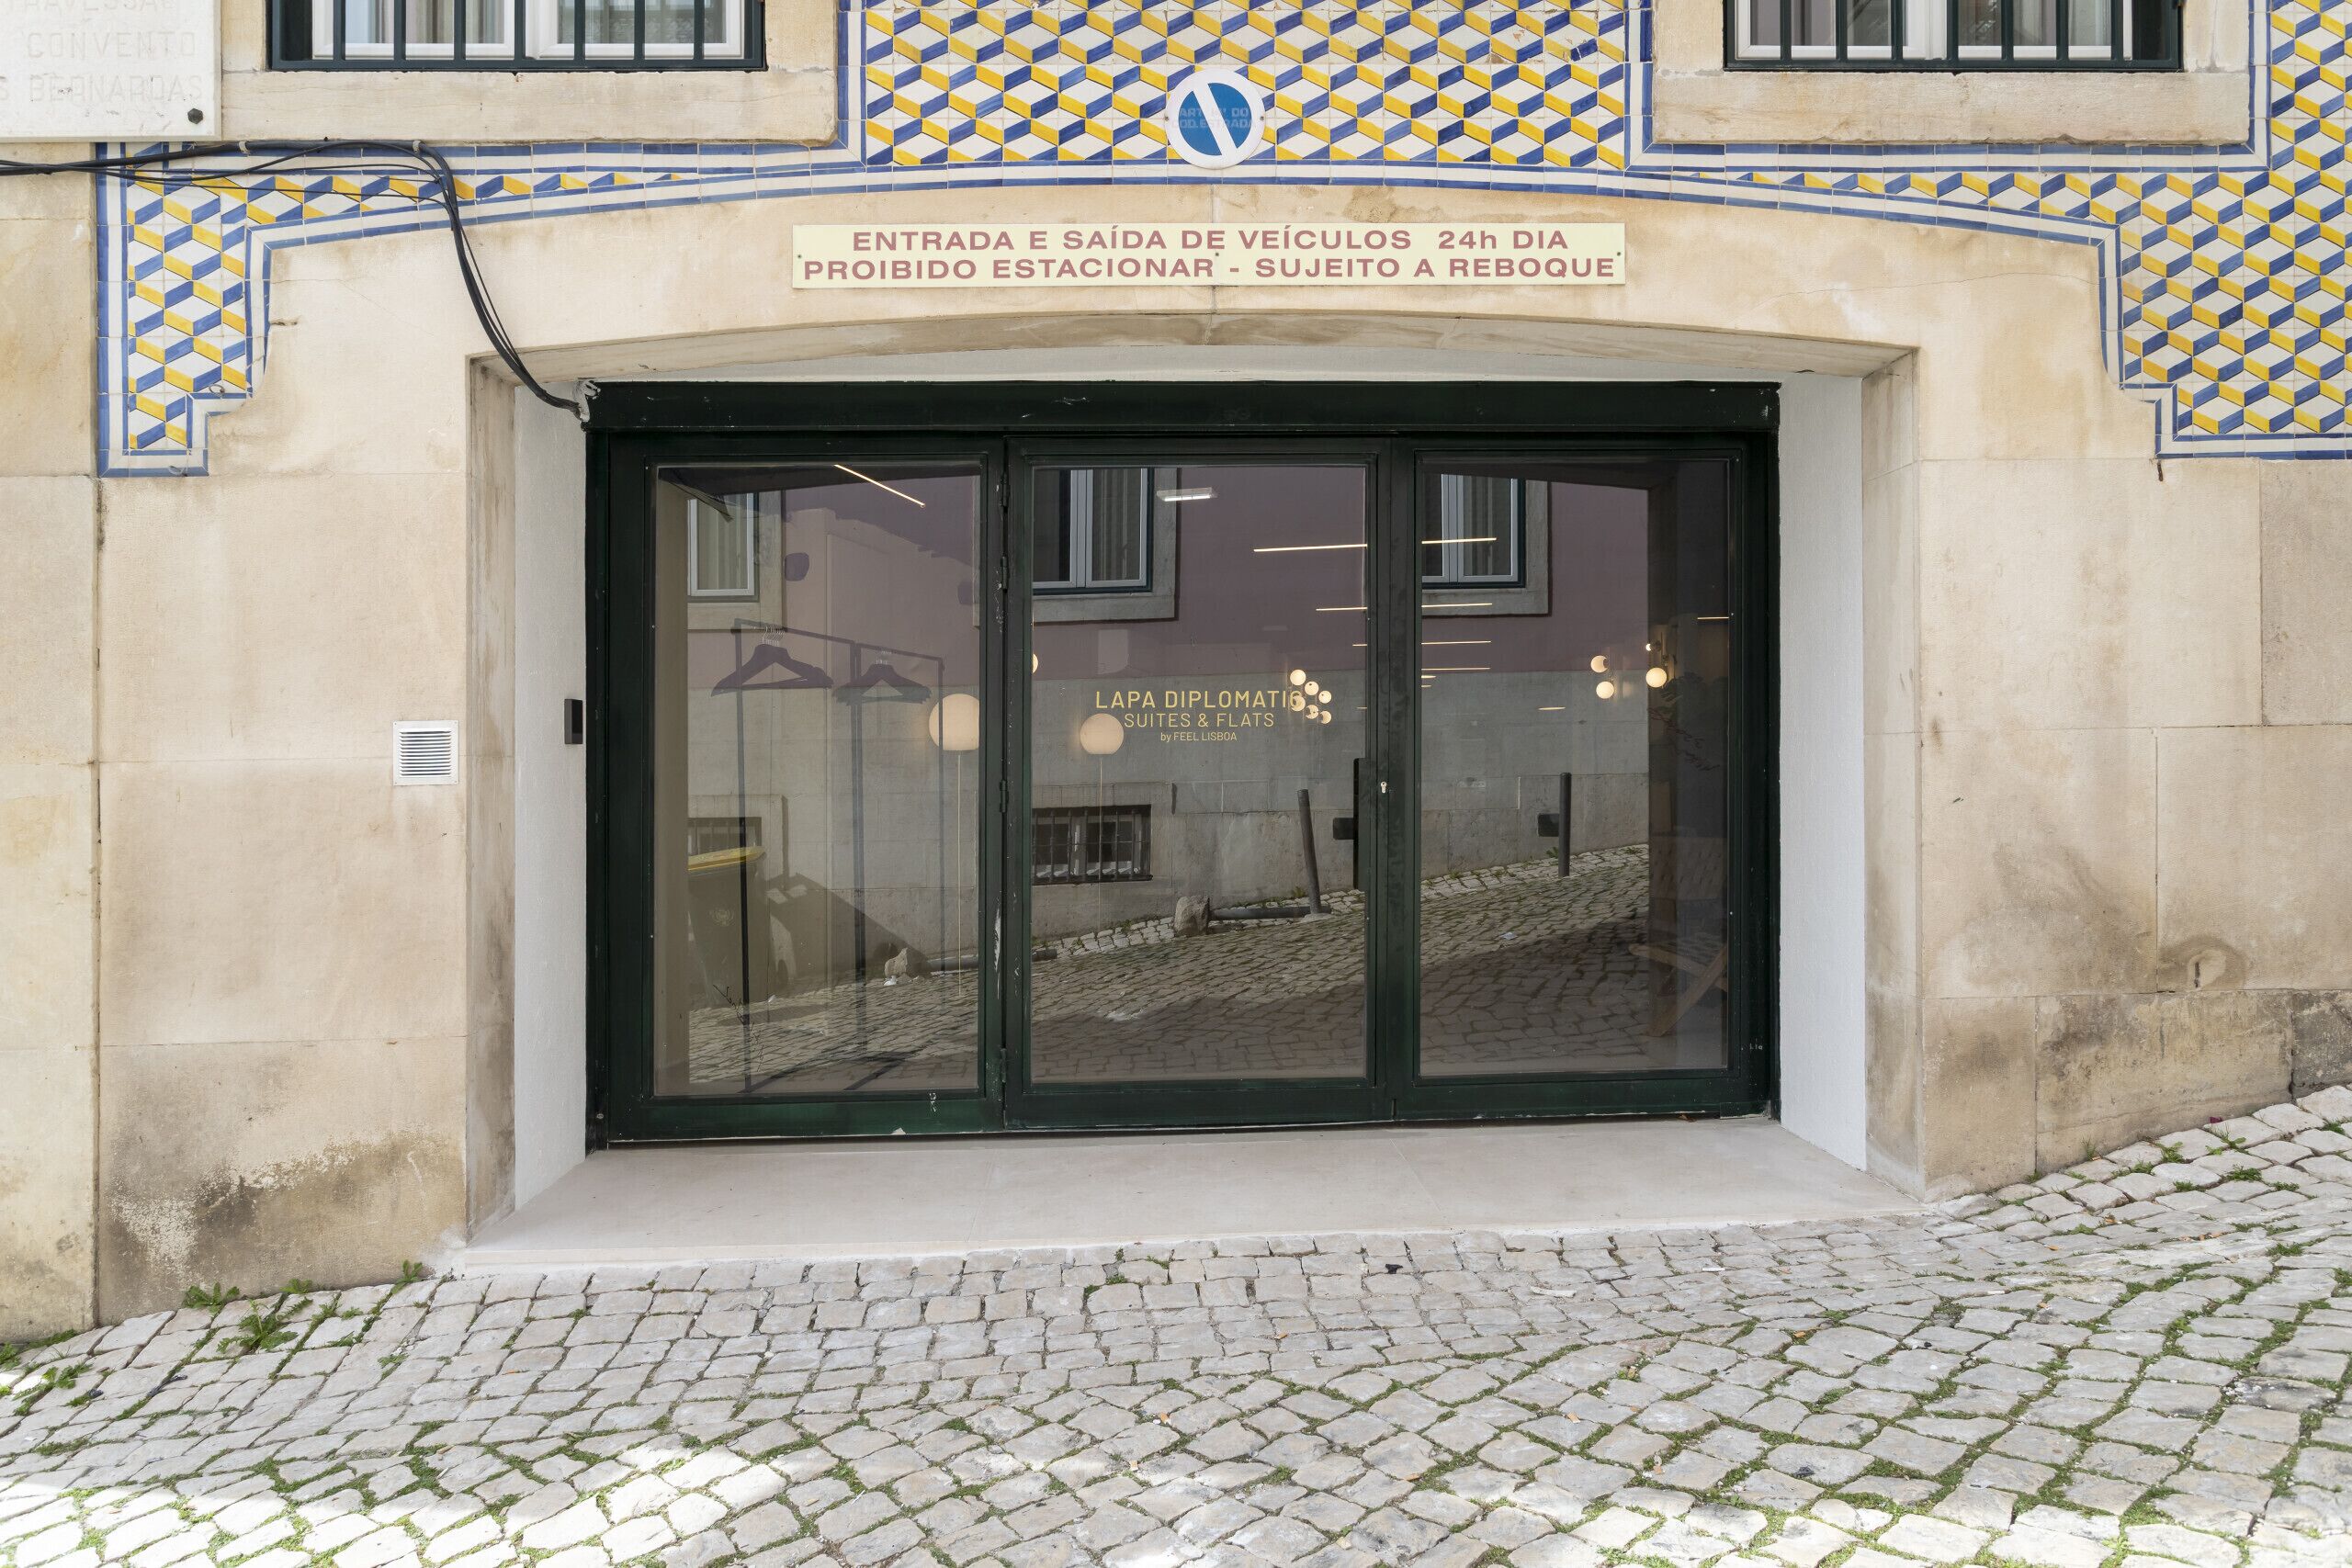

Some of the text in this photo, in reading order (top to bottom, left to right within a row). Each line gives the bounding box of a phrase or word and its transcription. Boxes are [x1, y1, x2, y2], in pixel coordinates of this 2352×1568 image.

[28, 31, 196, 58] CONVENTO
[853, 225, 1568, 251] ENTRADA E SAÍDA DE VEÍCULOS 24h DIA
[804, 259, 977, 280] PROIBIDO
[992, 257, 1214, 279] ESTACIONAR
[1255, 258, 1400, 278] SUJEITO
[1413, 258, 1435, 277] A
[1449, 258, 1615, 278] REBOQUE
[1096, 690, 1303, 708] LAPA DIPLOMATIC
[1124, 713, 1274, 728] SUITES & FLATS
[1160, 731, 1238, 743] by FEEL LISBOA
